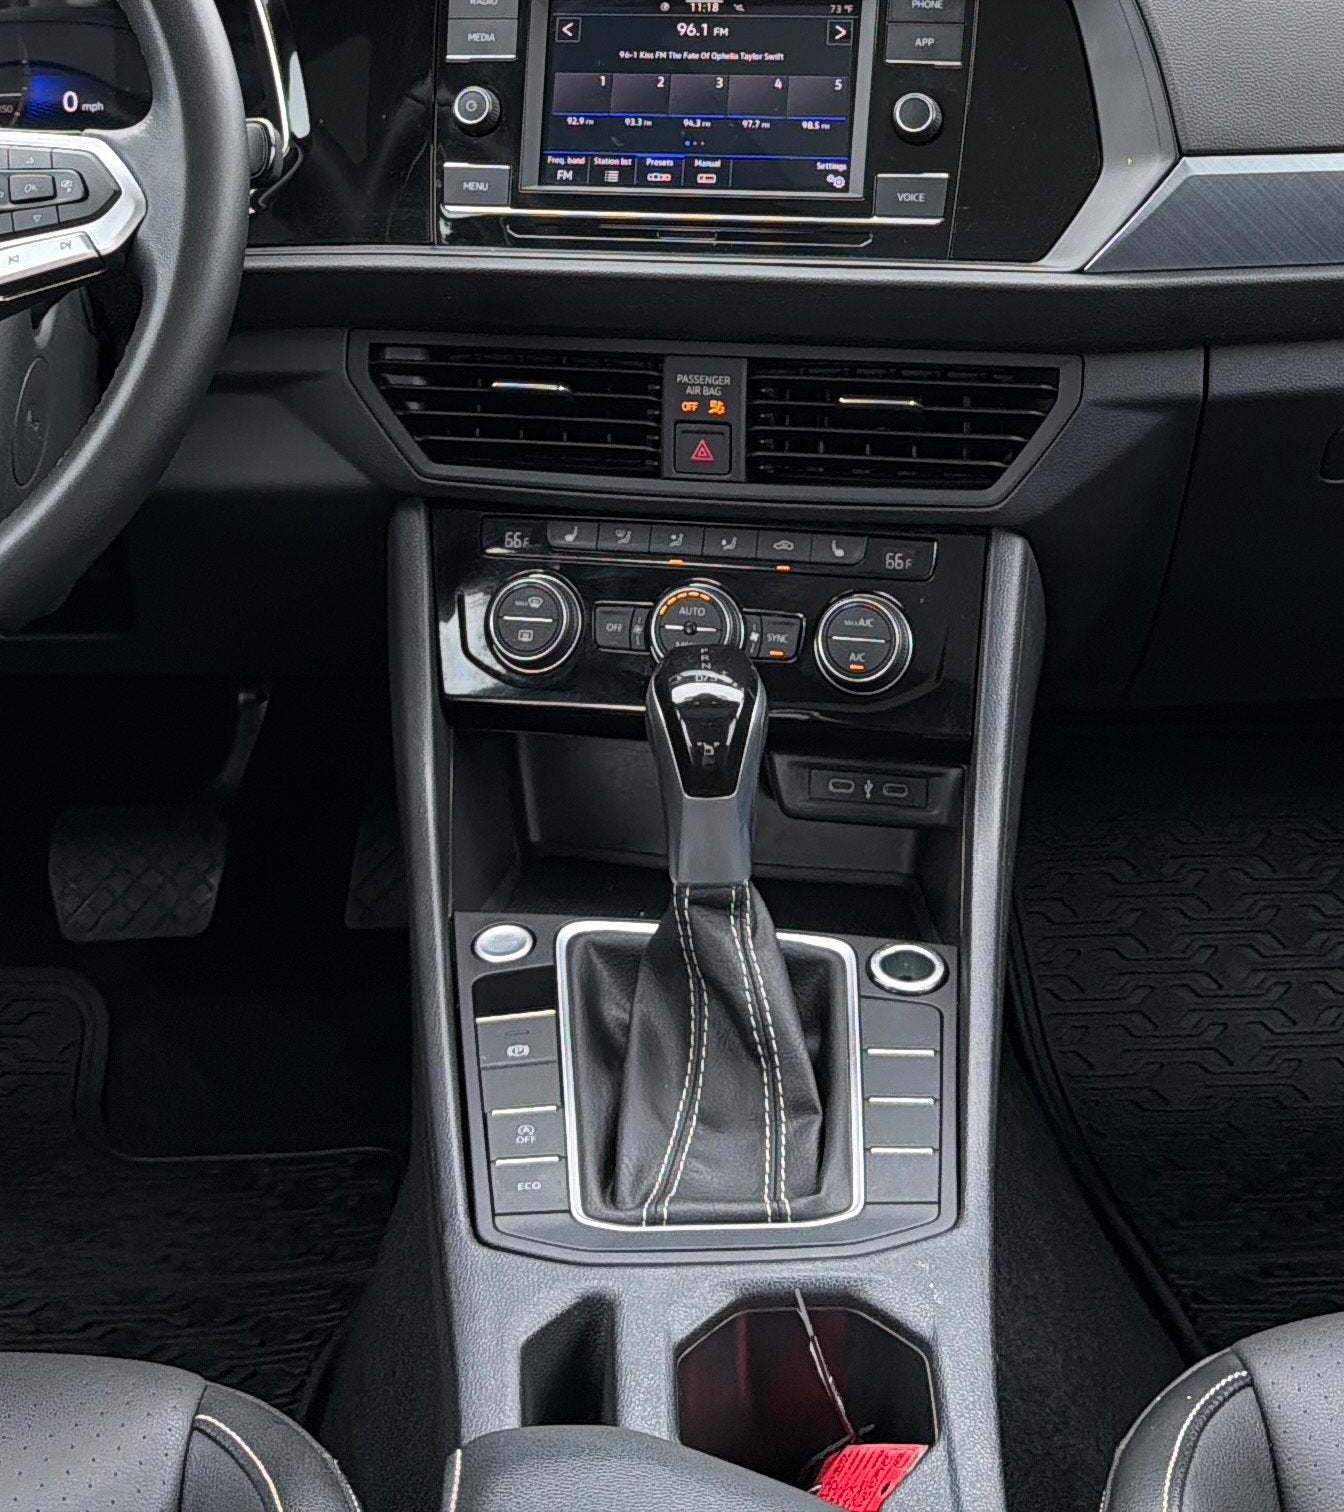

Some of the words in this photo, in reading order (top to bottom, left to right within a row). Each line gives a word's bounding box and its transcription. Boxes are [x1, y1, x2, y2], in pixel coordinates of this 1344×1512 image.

[689, 2, 720, 13] 11:18
[829, 4, 841, 14] 73
[911, 0, 943, 9] PHONE
[676, 22, 708, 36] 96.1
[713, 27, 729, 37] FM
[467, 32, 496, 42] MEDIA
[915, 37, 935, 47] APP
[619, 50, 637, 60] 96-1
[639, 50, 654, 60] Kiss
[655, 51, 666, 60] FM
[668, 51, 681, 61] The
[682, 51, 699, 61] Fate
[700, 51, 710, 61] Of
[711, 52, 738, 63] Ophelia
[739, 52, 763, 63] Taylor
[764, 52, 784, 62] Swift
[599, 76, 606, 87] 1
[657, 76, 665, 88] 2
[716, 78, 724, 89] 3
[774, 78, 783, 89] 4
[834, 79, 843, 90] 5
[62, 90, 78, 113] 0
[81, 100, 104, 113] mph
[566, 117, 585, 126] 92.9
[624, 117, 643, 127] 93.3
[682, 118, 701, 128] 94.3
[741, 119, 760, 129] 97.7
[801, 120, 820, 130] 98.5
[547, 156, 568, 166] Freq.
[569, 156, 586, 165] band
[593, 157, 617, 166] Station
[618, 157, 632, 166] list
[646, 158, 674, 168] Presets
[694, 158, 721, 168] Manual
[816, 161, 847, 172] Settings
[557, 170, 573, 180] FM
[24, 183, 37, 193] OK
[463, 181, 489, 191] MENU
[897, 192, 926, 202] VOICE
[676, 373, 731, 386] PASSENGER
[685, 386, 702, 395] AIR
[703, 386, 722, 396] BAG
[681, 401, 699, 412] OFF
[678, 607, 706, 617] AUTO
[606, 623, 623, 632] OFF
[858, 617, 874, 628] A/C
[766, 632, 789, 644] SYNC
[849, 652, 865, 662] A/C
[516, 1136, 536, 1145] OFF
[517, 1181, 541, 1191] ECO
